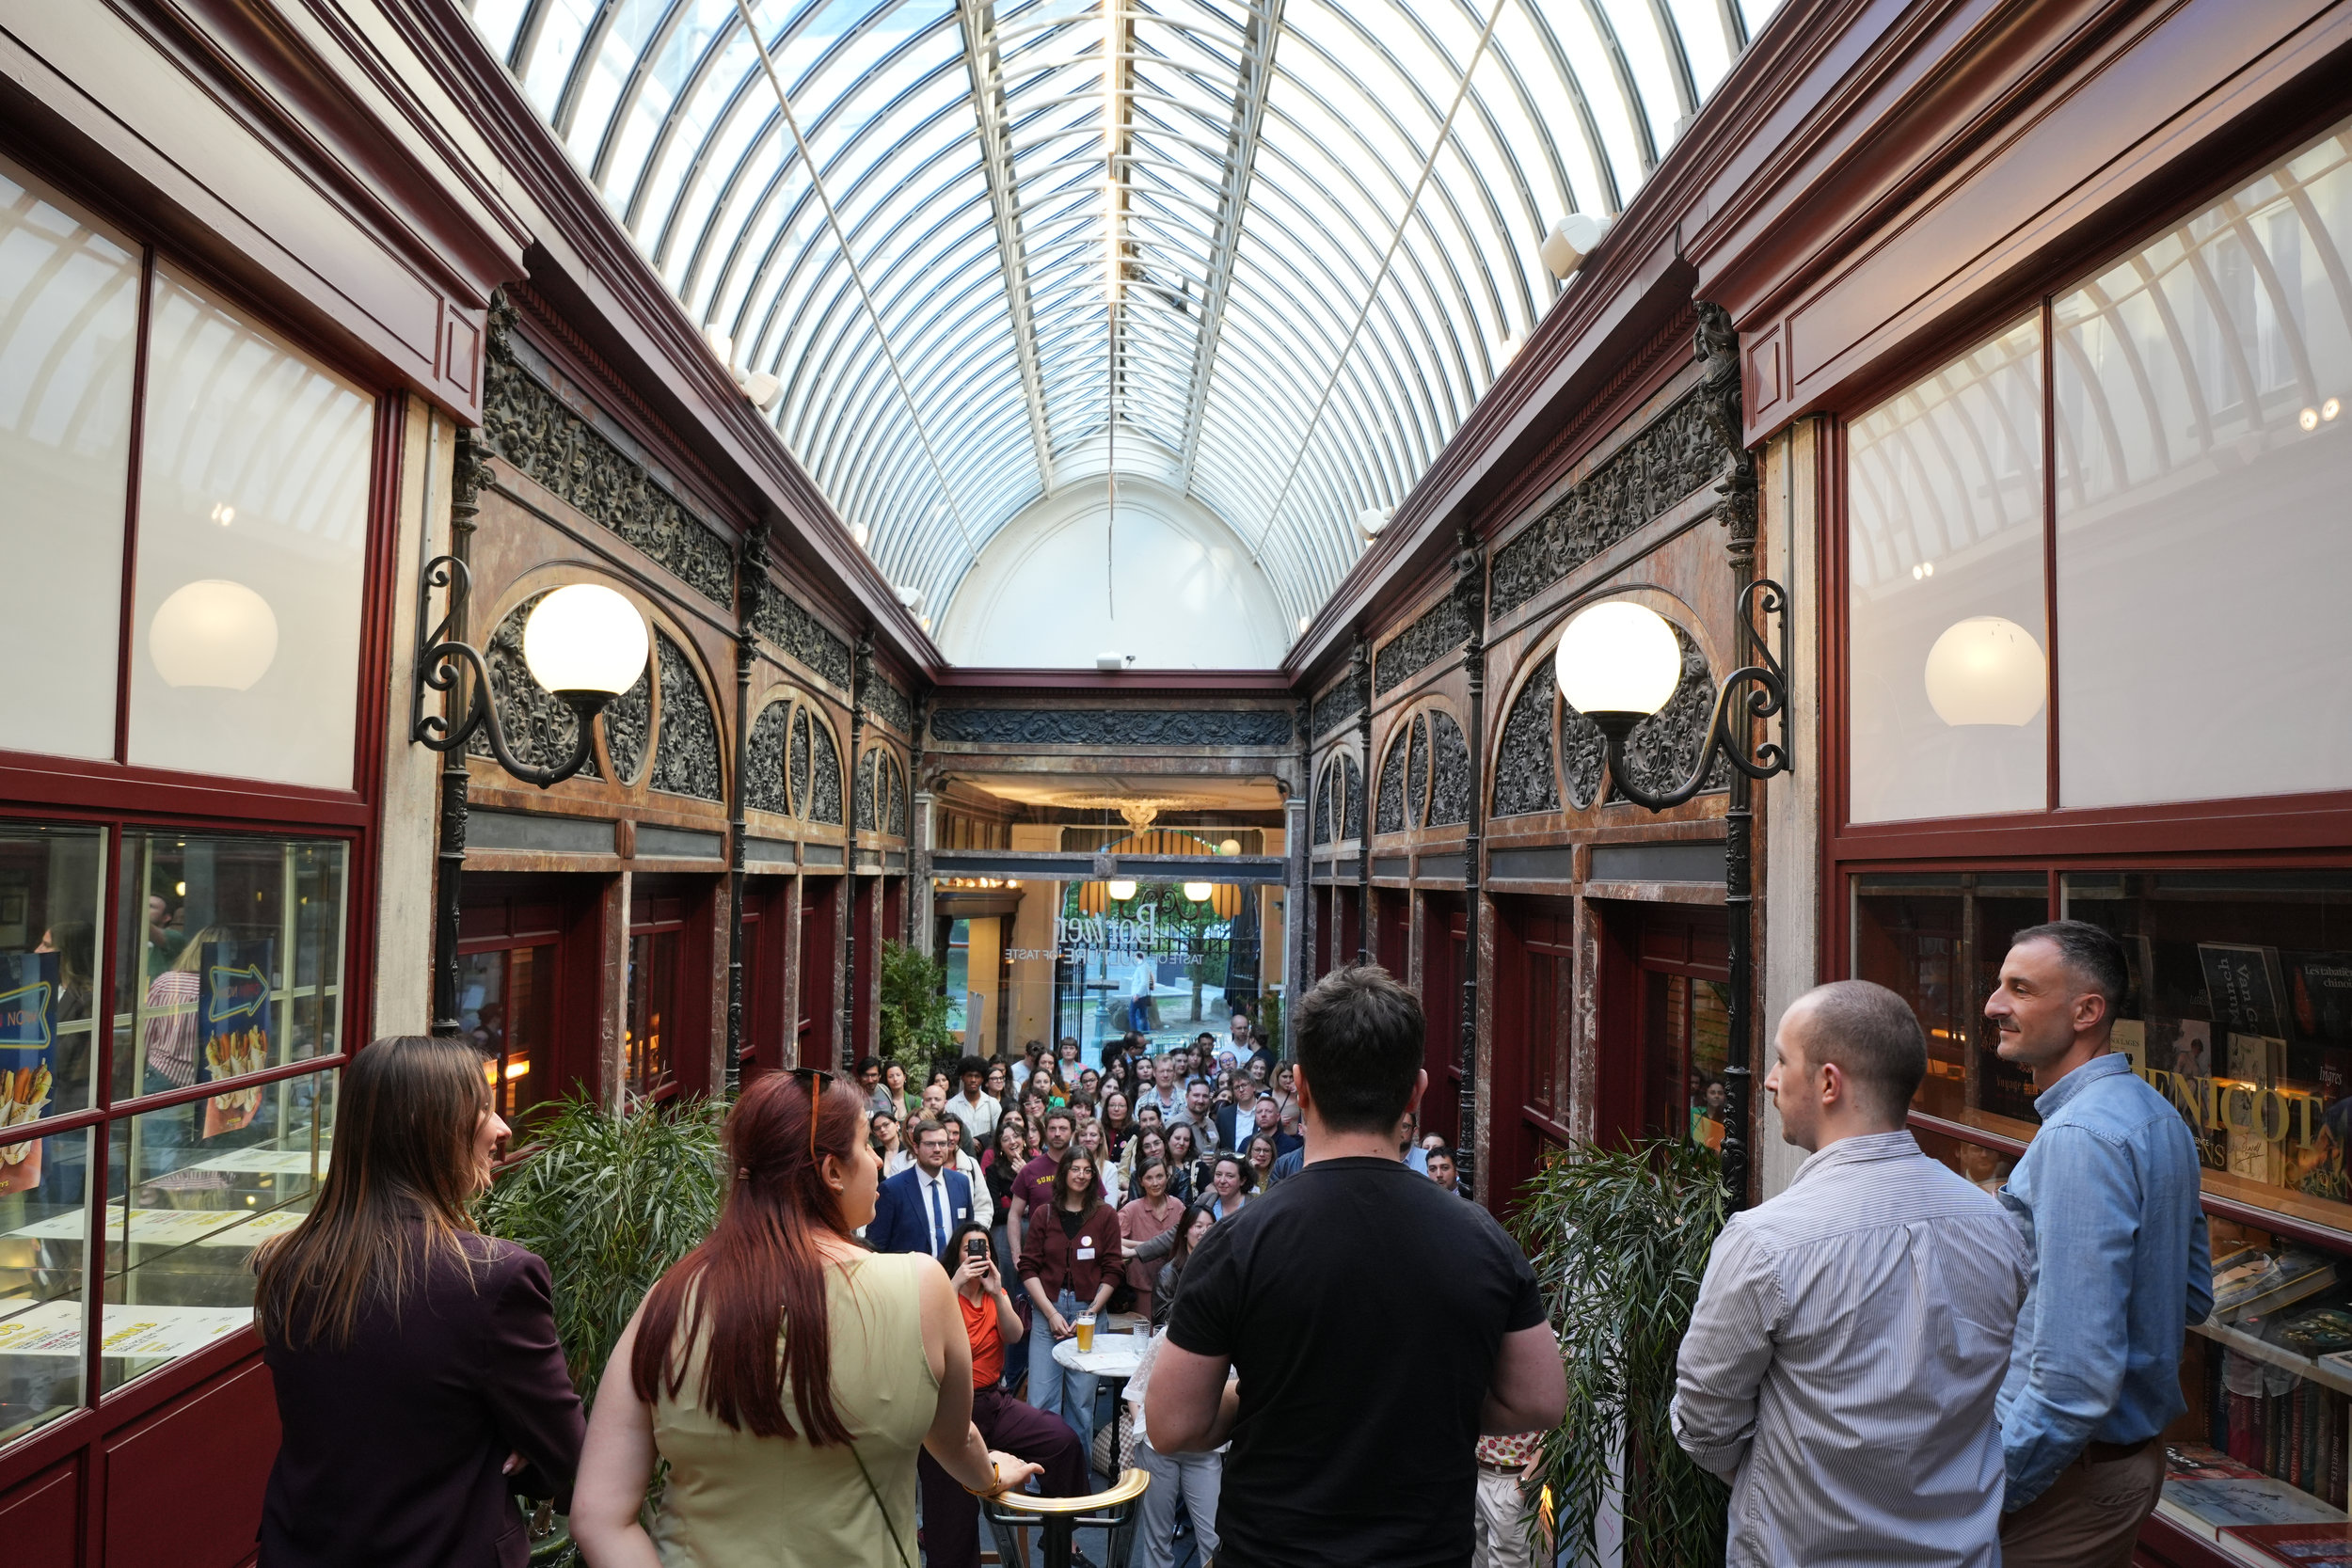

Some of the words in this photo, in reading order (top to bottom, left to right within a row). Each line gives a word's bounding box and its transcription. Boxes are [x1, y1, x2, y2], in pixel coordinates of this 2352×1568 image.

[2235, 963, 2251, 1003] Van
[2304, 965, 2320, 975] Les
[2217, 958, 2243, 1025] Munch
[8, 1009, 38, 1027] NOW
[2318, 1066, 2343, 1087] Ingres
[2130, 1065, 2324, 1152] ENICOT
[2329, 1435, 2340, 1482] BRUXELLES
